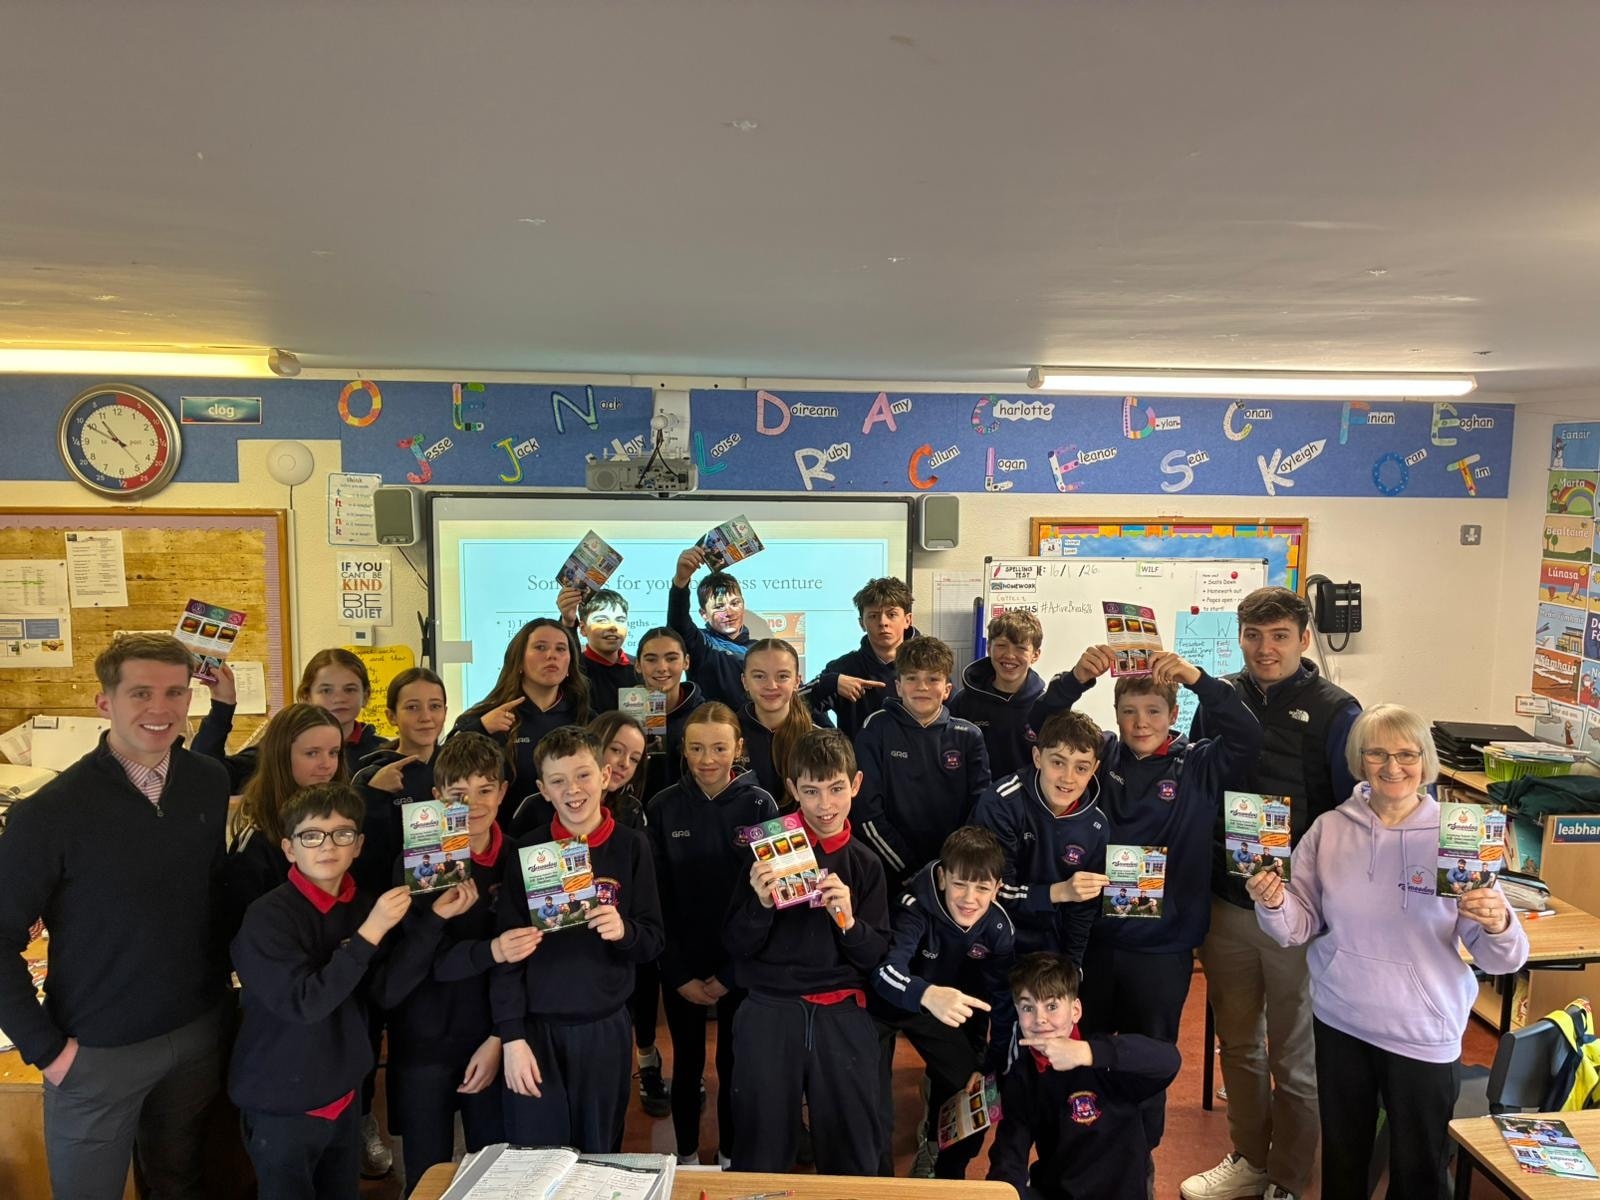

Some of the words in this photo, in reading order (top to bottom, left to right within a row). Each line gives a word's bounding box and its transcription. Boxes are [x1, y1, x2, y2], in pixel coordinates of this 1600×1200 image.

[208, 404, 235, 418] clog
[756, 391, 838, 435] Doireann
[862, 392, 912, 434] Amy
[971, 395, 1053, 434] Charlotte
[1223, 400, 1271, 441] Conan
[1431, 402, 1493, 445] Eoghan
[795, 444, 849, 490] Ruby
[985, 447, 1026, 490] Logan
[1257, 444, 1318, 496] Kayleigh
[341, 562, 351, 571] IF
[355, 562, 382, 572] YOU
[342, 579, 382, 591] KIND
[616, 574, 641, 590] for
[763, 577, 823, 590] venture
[343, 593, 382, 608] BE
[343, 608, 382, 619] QUIET
